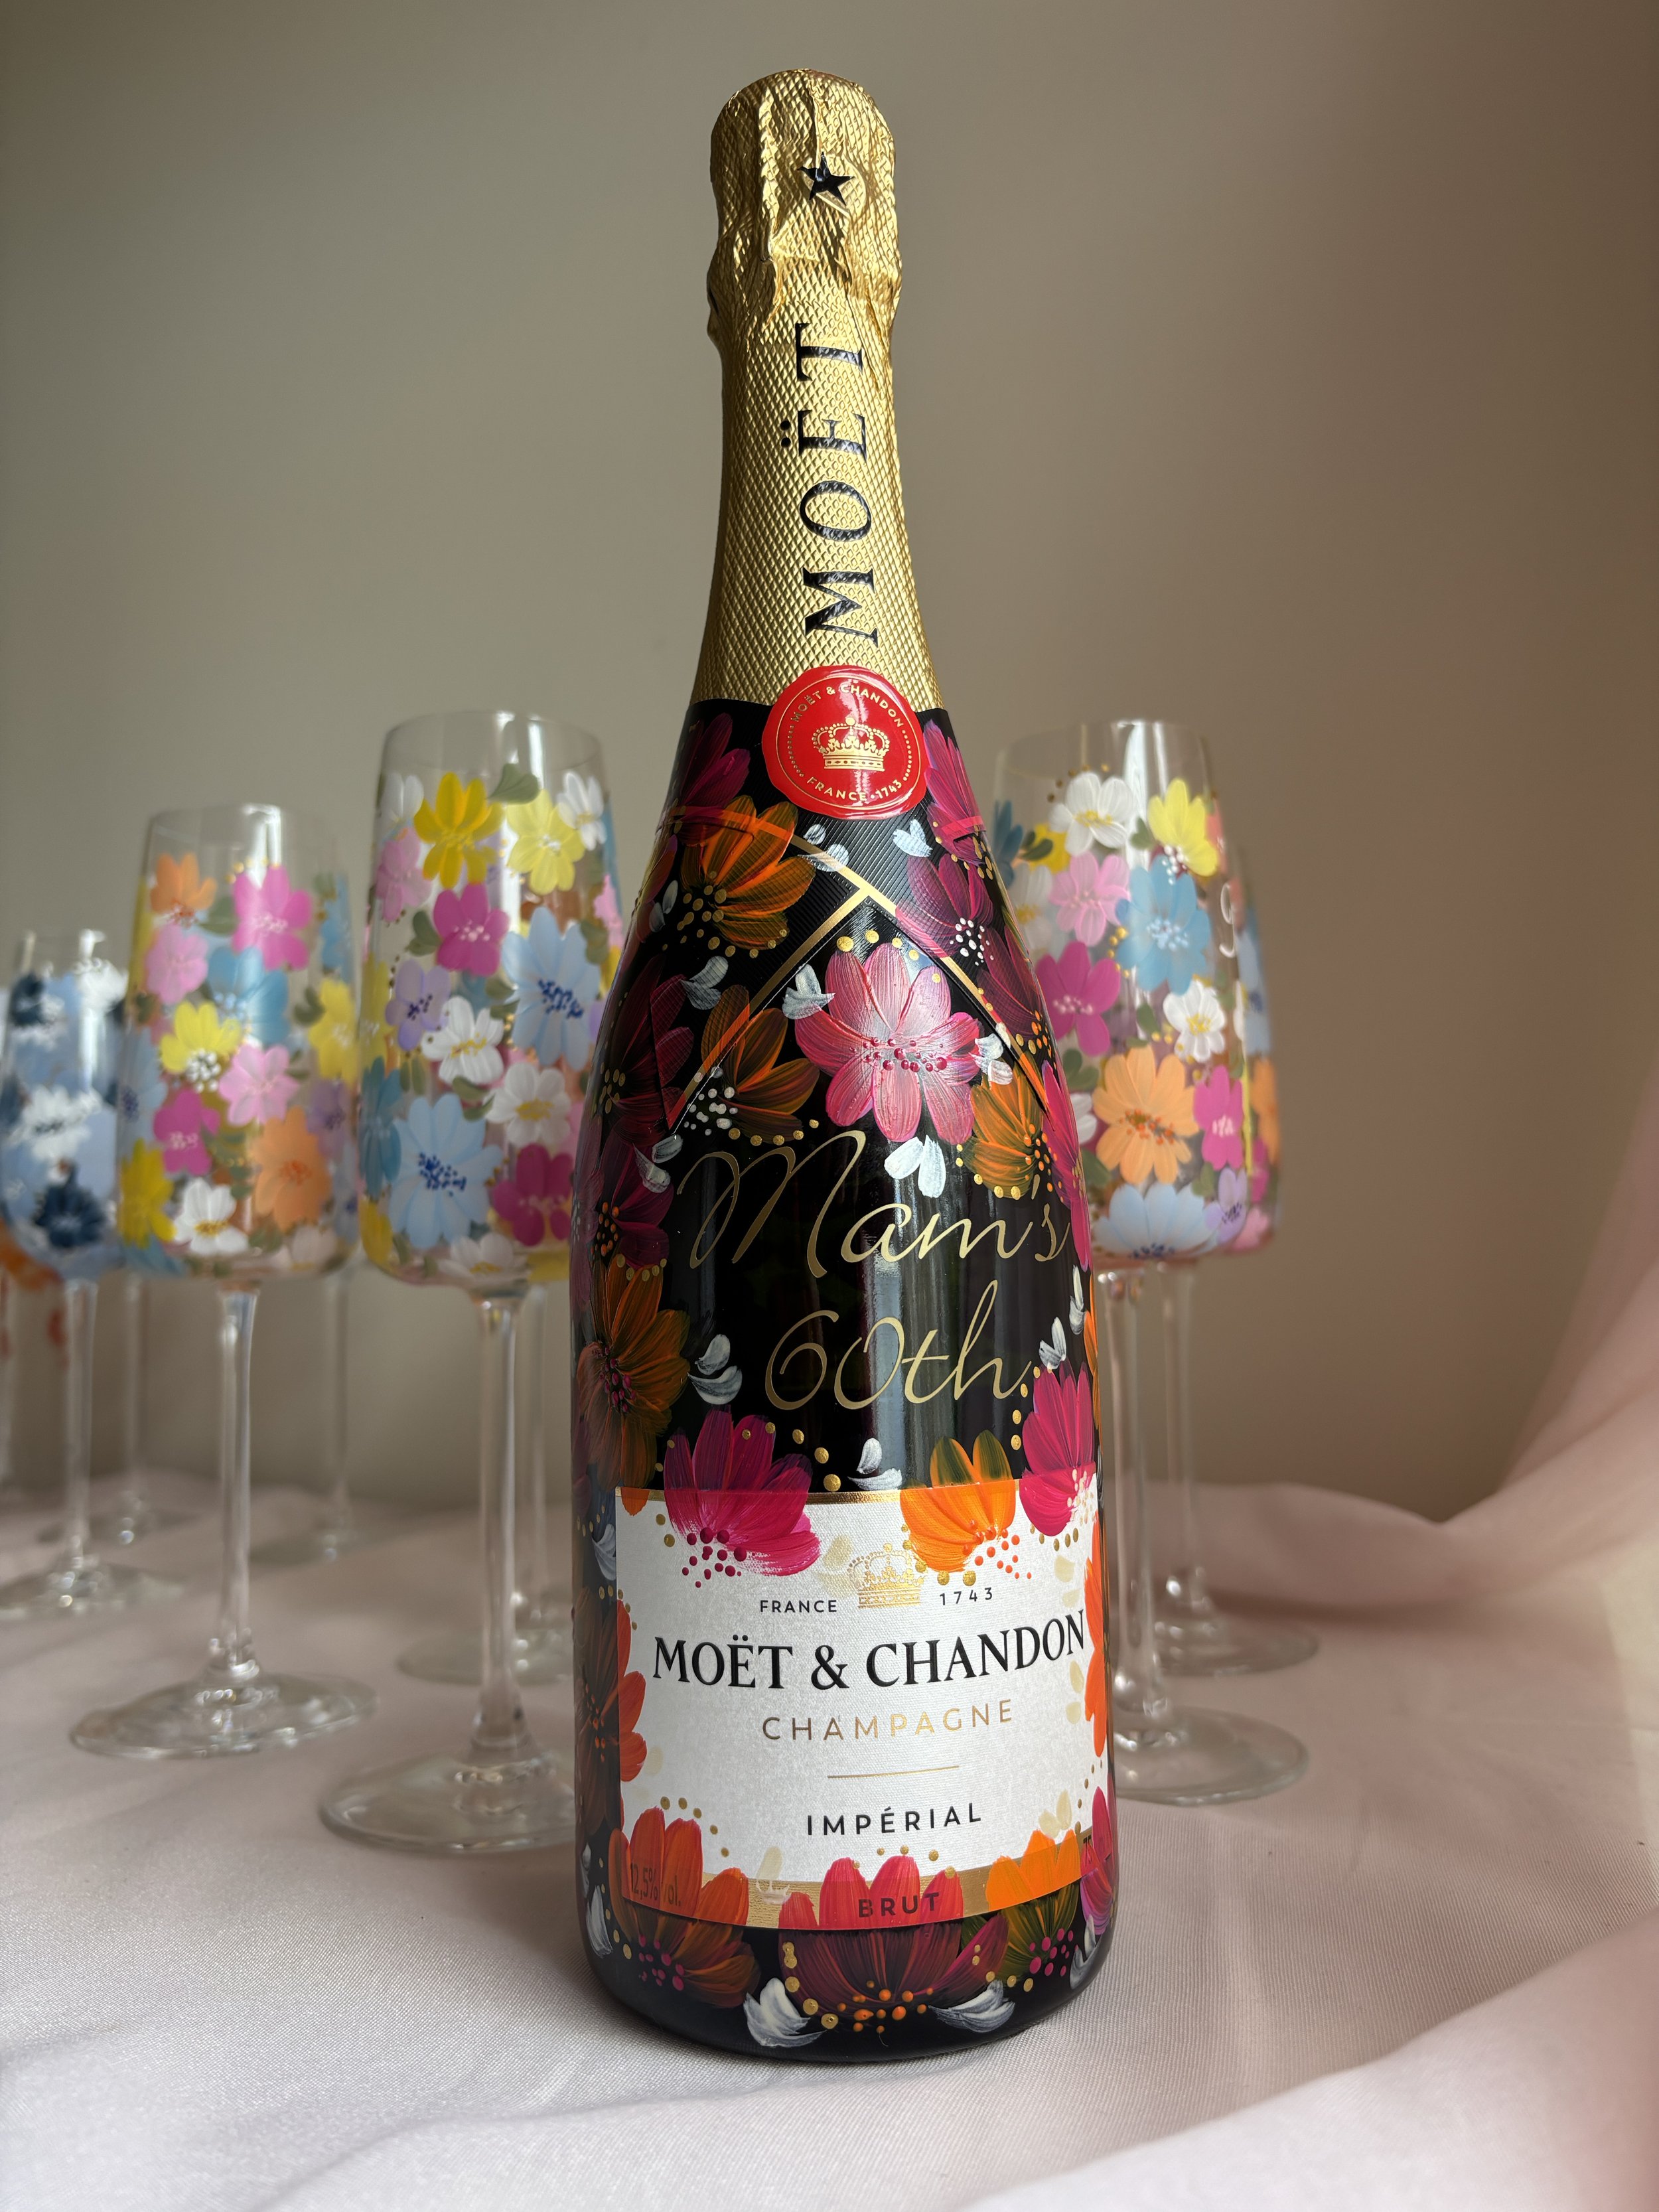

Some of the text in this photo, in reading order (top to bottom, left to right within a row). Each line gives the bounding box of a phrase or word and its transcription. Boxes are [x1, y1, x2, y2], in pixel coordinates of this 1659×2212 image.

[780, 323, 879, 648] MOËT
[790, 683, 904, 728] MOËT & CHANDON
[806, 776, 903, 801] FRANCE 1743
[676, 1130, 1070, 1278] Mam's
[764, 1280, 1032, 1410] 60th
[760, 1587, 993, 1613] FRANCE 1743
[652, 1609, 1085, 1690] MOËT & CHANDON
[762, 1698, 1012, 1741] CHAMPAGNE
[807, 1802, 981, 1836] IMPÉRIAL
[630, 1862, 658, 1900] 12,5%
[858, 1891, 940, 1918] BRUT
